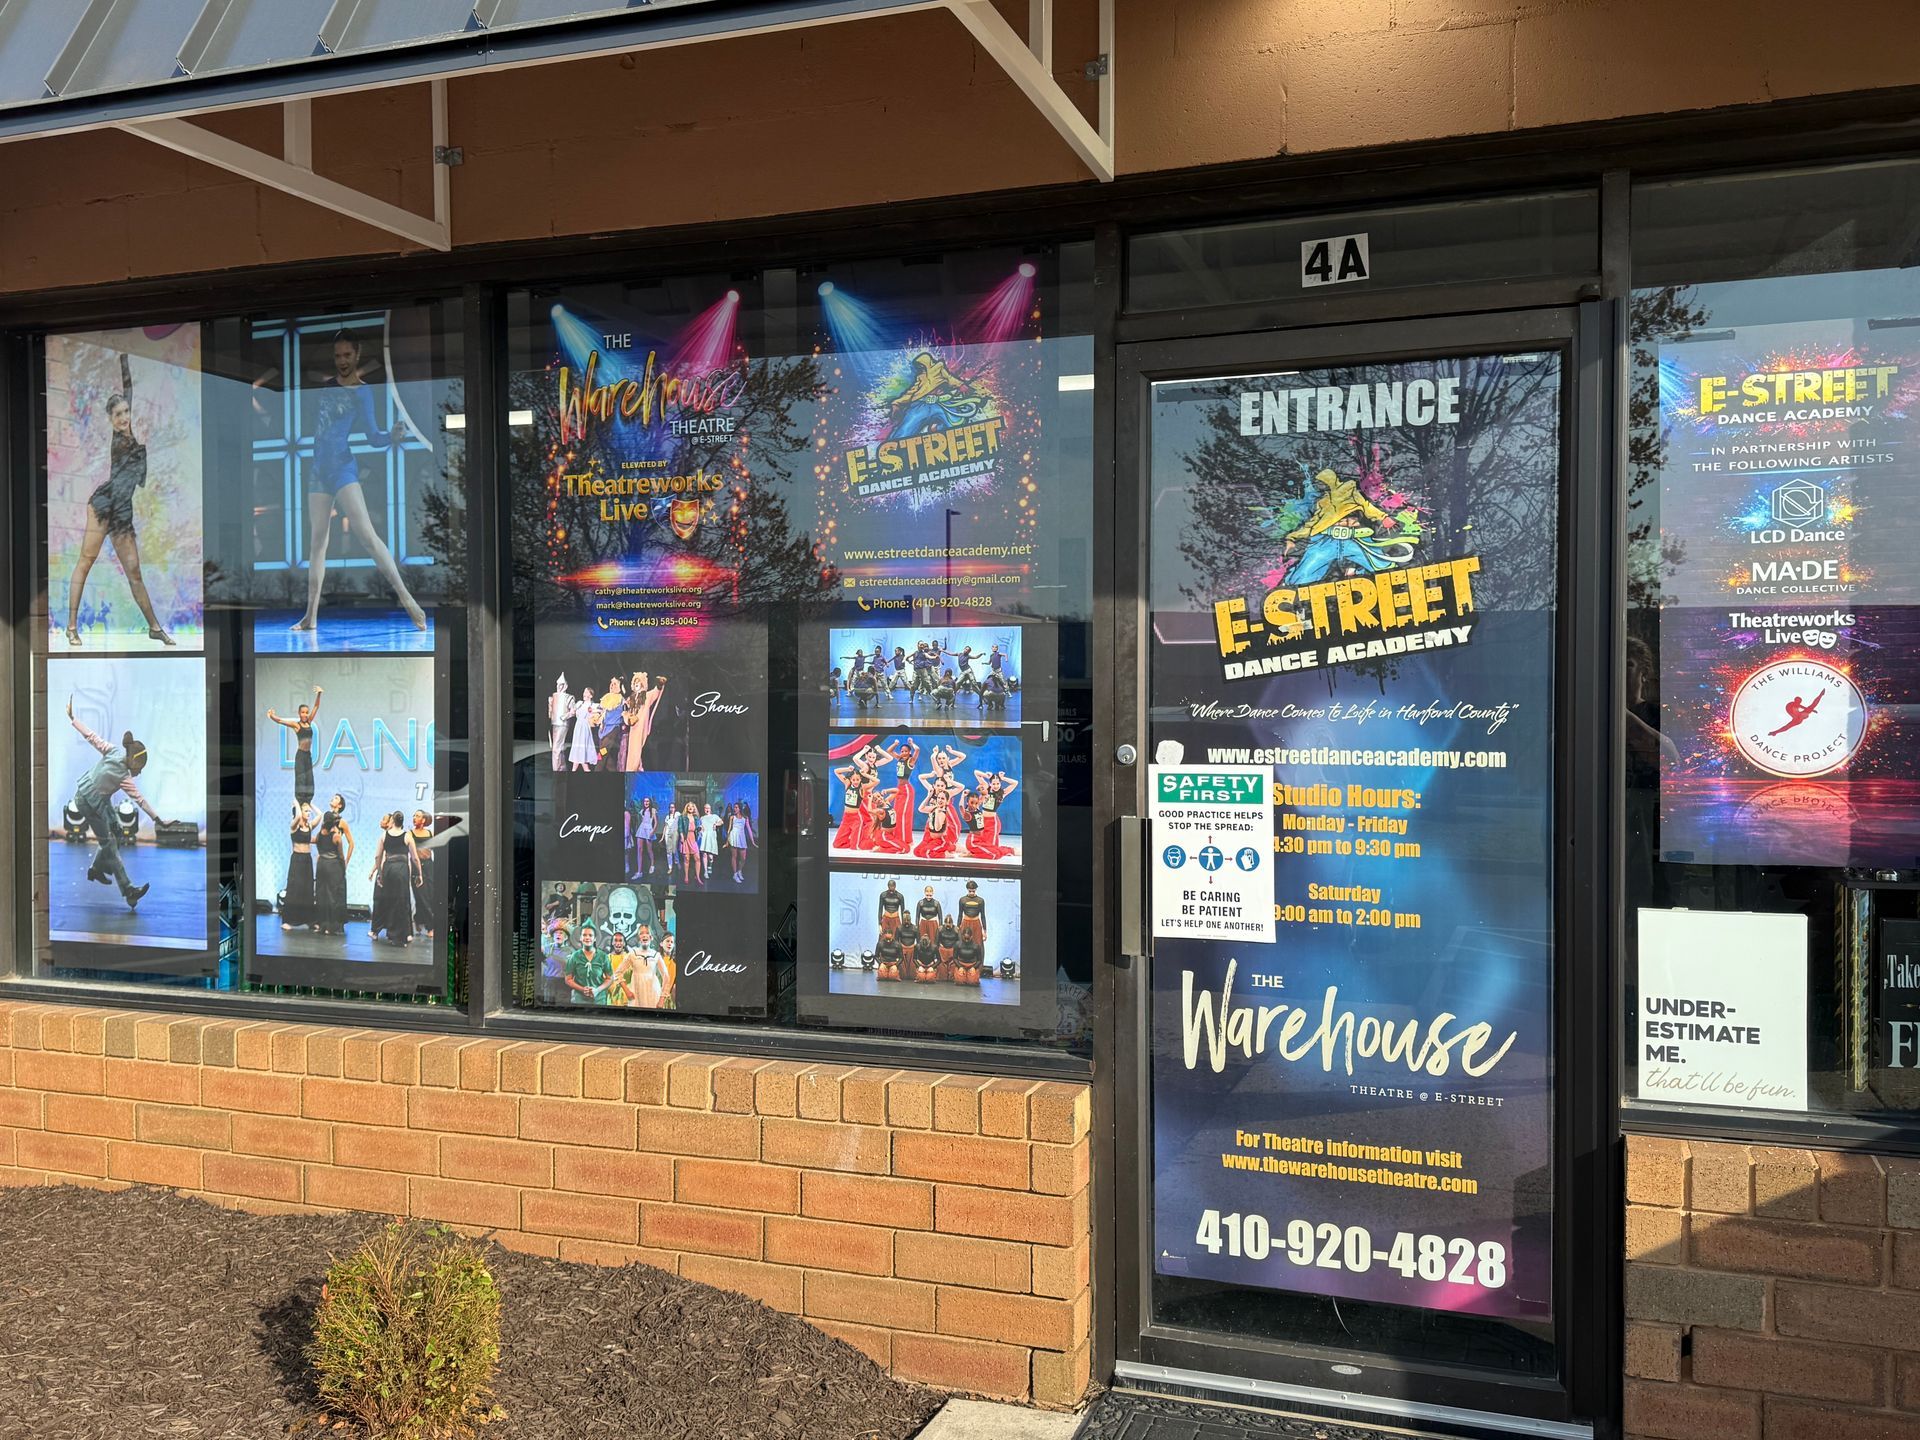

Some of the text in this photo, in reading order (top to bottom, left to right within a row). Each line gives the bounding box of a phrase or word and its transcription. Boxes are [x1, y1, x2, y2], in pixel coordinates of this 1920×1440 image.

[1304, 237, 1368, 282] 4A
[603, 333, 632, 349] THE
[559, 351, 748, 446] Warehouse
[1700, 366, 1898, 415] E-STREET
[1239, 377, 1461, 436] ENTRANCE
[1717, 405, 1874, 425] DANCE ACADEMY
[669, 417, 735, 435] THEATRE
[691, 435, 733, 445] @ E-STREET
[1711, 438, 1877, 456] IN PARTNERSHIP WITH
[845, 418, 1002, 486] E-STREET
[1692, 453, 1894, 472] THE FOLLOWING ARTISTS
[621, 460, 668, 469] ELEVATED BY
[563, 469, 725, 497] Theatreworks
[858, 458, 996, 496] DANCE ACADEMY
[599, 498, 648, 522] Live
[1751, 528, 1846, 544] LCD Dance
[844, 544, 1031, 560] www.estreetdanceacademy.net
[859, 574, 1021, 587] estreetdanceacademy@gmail.com
[1736, 584, 1855, 595] DANCE COLLECTIVE
[595, 586, 703, 597] cathy@theatreworkslive.org
[596, 600, 702, 610] mark@theatreworkslive.org
[873, 596, 993, 610] Phone: (410-920-4828
[1214, 556, 1481, 658] E-STREET
[609, 617, 698, 627] Phone: (443) 585-0045
[1728, 610, 1856, 628] Theatreworks
[1764, 630, 1801, 644] Live
[1224, 625, 1473, 680] DANCE ACADEMY
[1751, 667, 1843, 692] THE WILLIAMS
[690, 691, 750, 718] Shows
[1233, 703, 1279, 718] Dance
[1281, 703, 1326, 718] Comes
[1329, 702, 1344, 721] to
[1342, 700, 1377, 725] Life
[1378, 707, 1392, 719] in
[1396, 700, 1463, 726] Harford
[1207, 747, 1507, 769] www.estreetdanceacademy.com
[1749, 733, 1847, 763] DANCE PROJECT
[1163, 775, 1258, 793] SAFETY
[1180, 790, 1245, 801] FIRST
[1273, 782, 1421, 808] Studio Hours:
[1158, 810, 1264, 820] GOOD PRACTICE HELPS
[1282, 813, 1346, 833] Monday
[1357, 815, 1408, 835] Friday
[559, 813, 613, 843] Camps
[1168, 822, 1254, 832] STOP THE SPREAD:
[1307, 840, 1333, 855] pm
[1335, 839, 1352, 855] to
[1355, 839, 1391, 856] 9:30
[1394, 842, 1421, 858] pm
[1183, 890, 1241, 903] BE CARING
[1308, 883, 1381, 905] Saturday
[1182, 905, 1243, 917] BE PATIENT
[1308, 909, 1334, 923] am
[1336, 908, 1353, 924] to
[1356, 909, 1391, 926] 2:00
[1394, 912, 1421, 928] pm
[1161, 918, 1264, 932] LET'S HELP ONE ANOTHER!
[684, 951, 748, 976] Classes
[1252, 974, 1284, 989] THE
[1182, 958, 1517, 1077] Warehouse
[1645, 997, 1737, 1019] UNDER-
[1645, 1021, 1761, 1044] ESTIMATE
[1645, 1044, 1687, 1064] ME.
[1645, 1066, 1797, 1101] that'll be fun.
[1350, 1085, 1504, 1107] THEATRE @ E-STREET
[1236, 1129, 1463, 1169] For Theatre information visit
[1222, 1153, 1478, 1195] www.thewarehousetheatre.com
[1195, 1208, 1507, 1289] 410-920-4828
